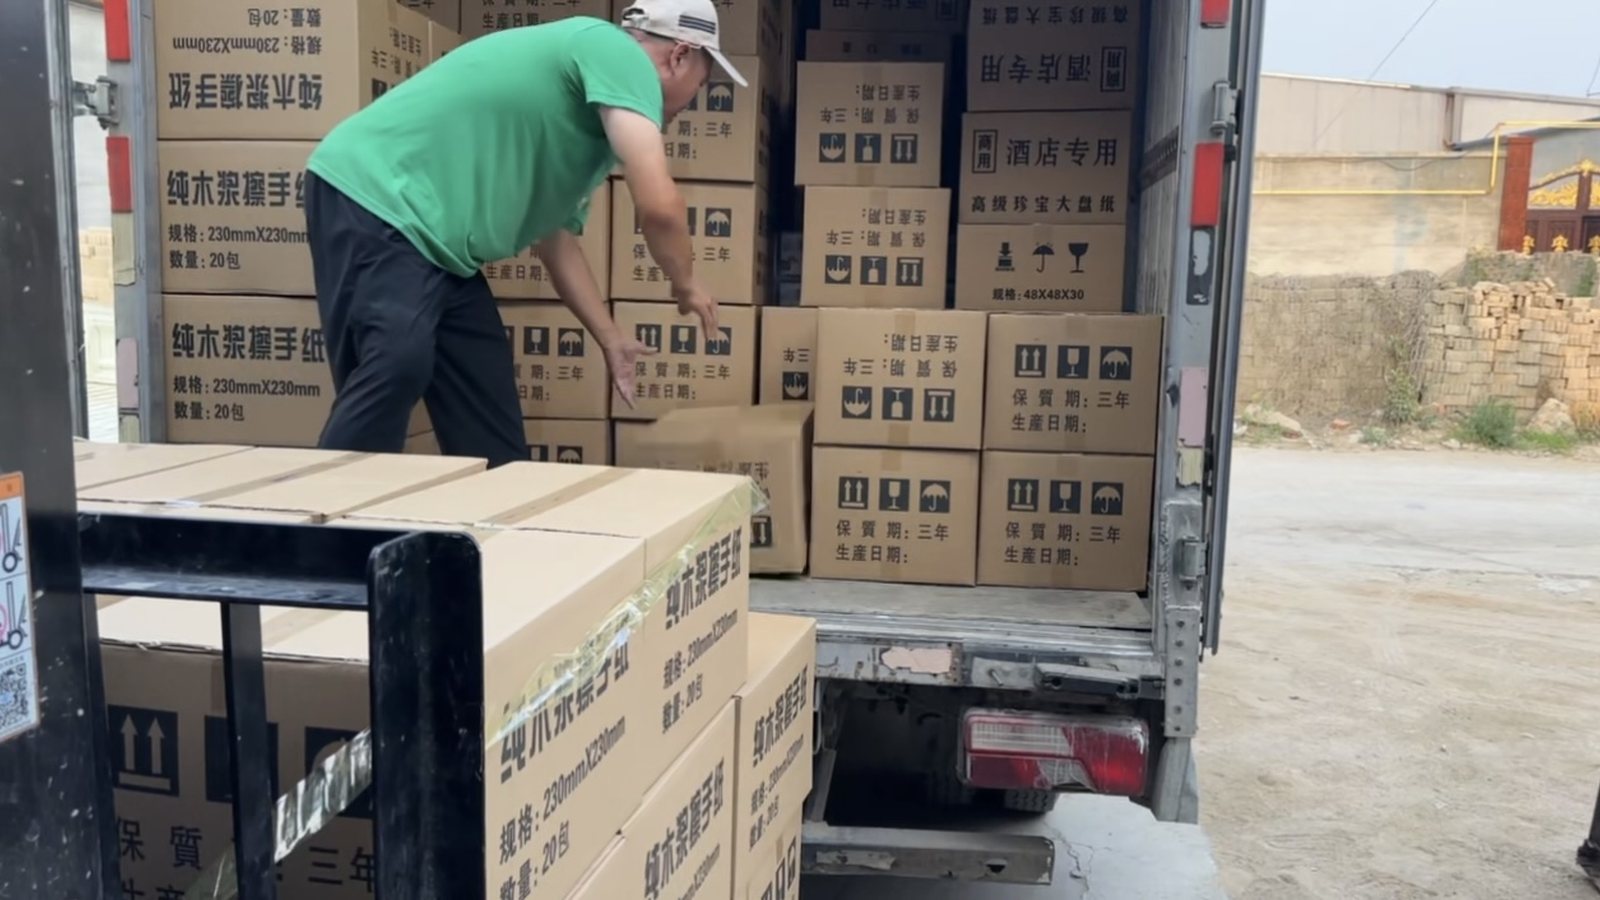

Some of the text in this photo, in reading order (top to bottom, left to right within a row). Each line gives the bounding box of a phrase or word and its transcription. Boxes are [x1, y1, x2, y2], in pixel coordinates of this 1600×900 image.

[981, 53, 1091, 84] 酒店专用
[169, 73, 322, 110] 纯木浆擦手纸
[1006, 137, 1118, 166] 酒店专用
[971, 195, 1115, 213] 高级珍宝大盘纸
[172, 323, 325, 362] 纯木浆擦手纸
